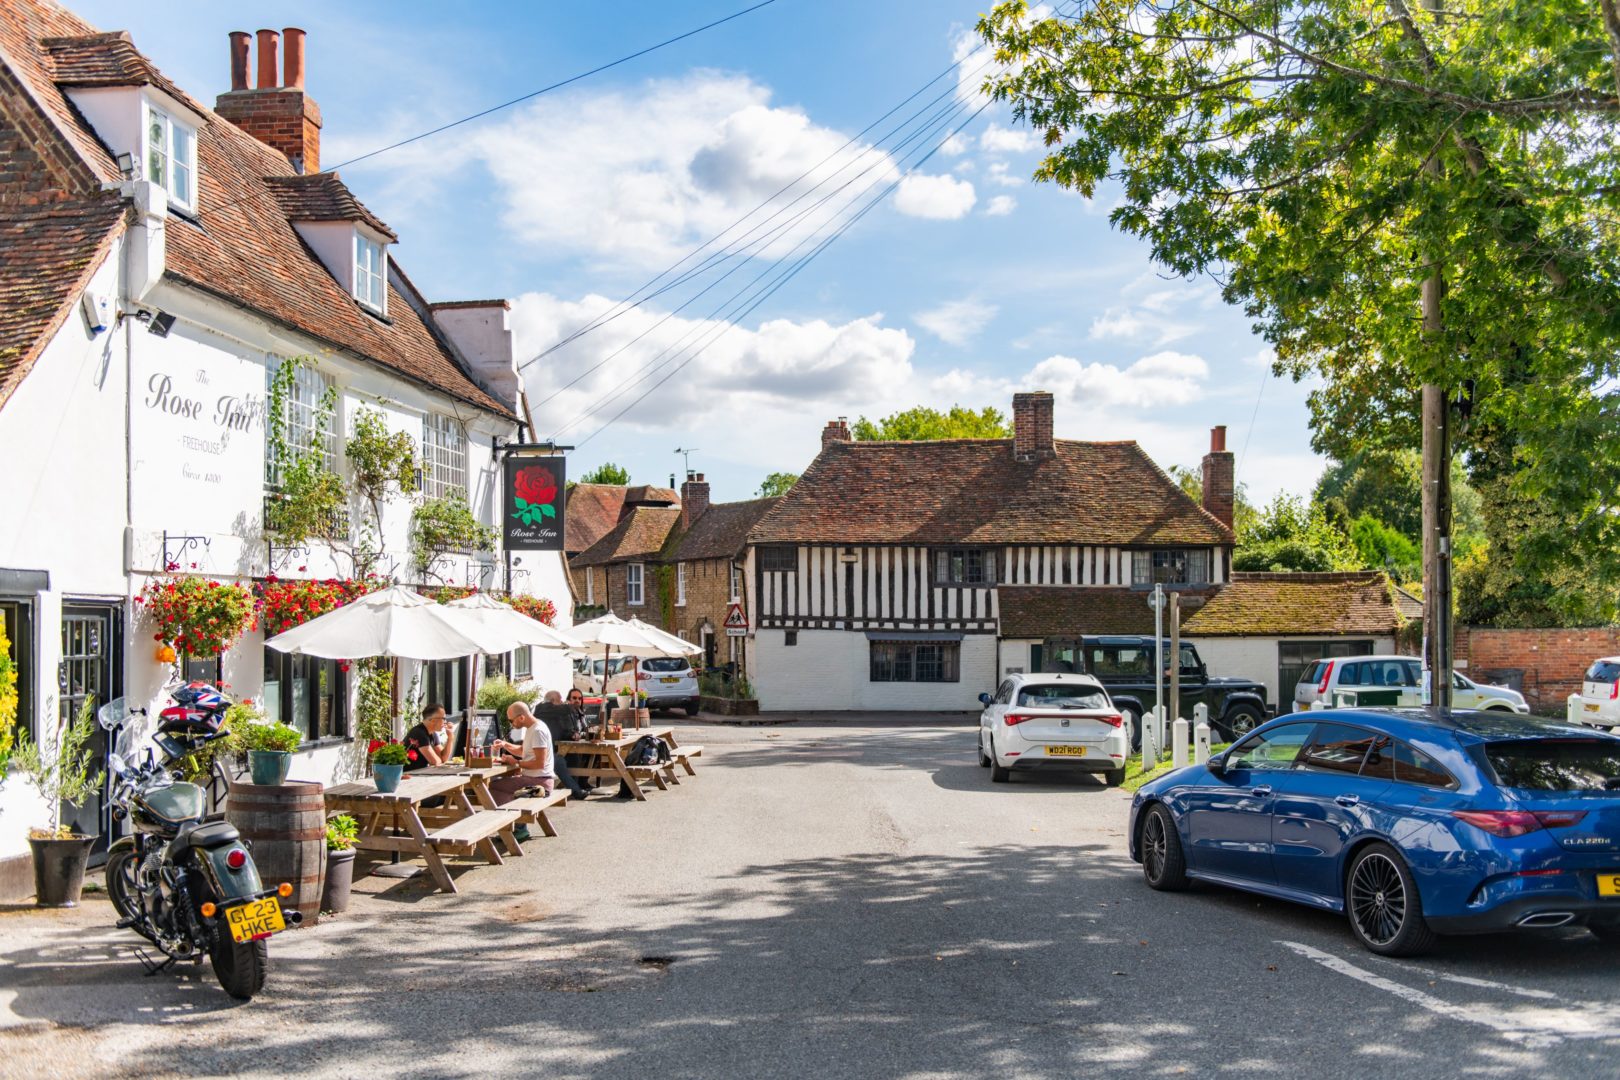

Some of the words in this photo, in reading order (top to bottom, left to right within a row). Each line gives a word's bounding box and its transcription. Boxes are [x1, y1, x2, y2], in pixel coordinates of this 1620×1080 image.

[145, 373, 202, 420] Rose
[213, 395, 251, 433] Inn
[182, 435, 220, 455] FREEHOUSE
[510, 528, 534, 537] Rose
[538, 528, 557, 537] Inn
[1585, 837, 1611, 845] 220d
[229, 900, 277, 924] GL23
[240, 916, 277, 938] HKE
